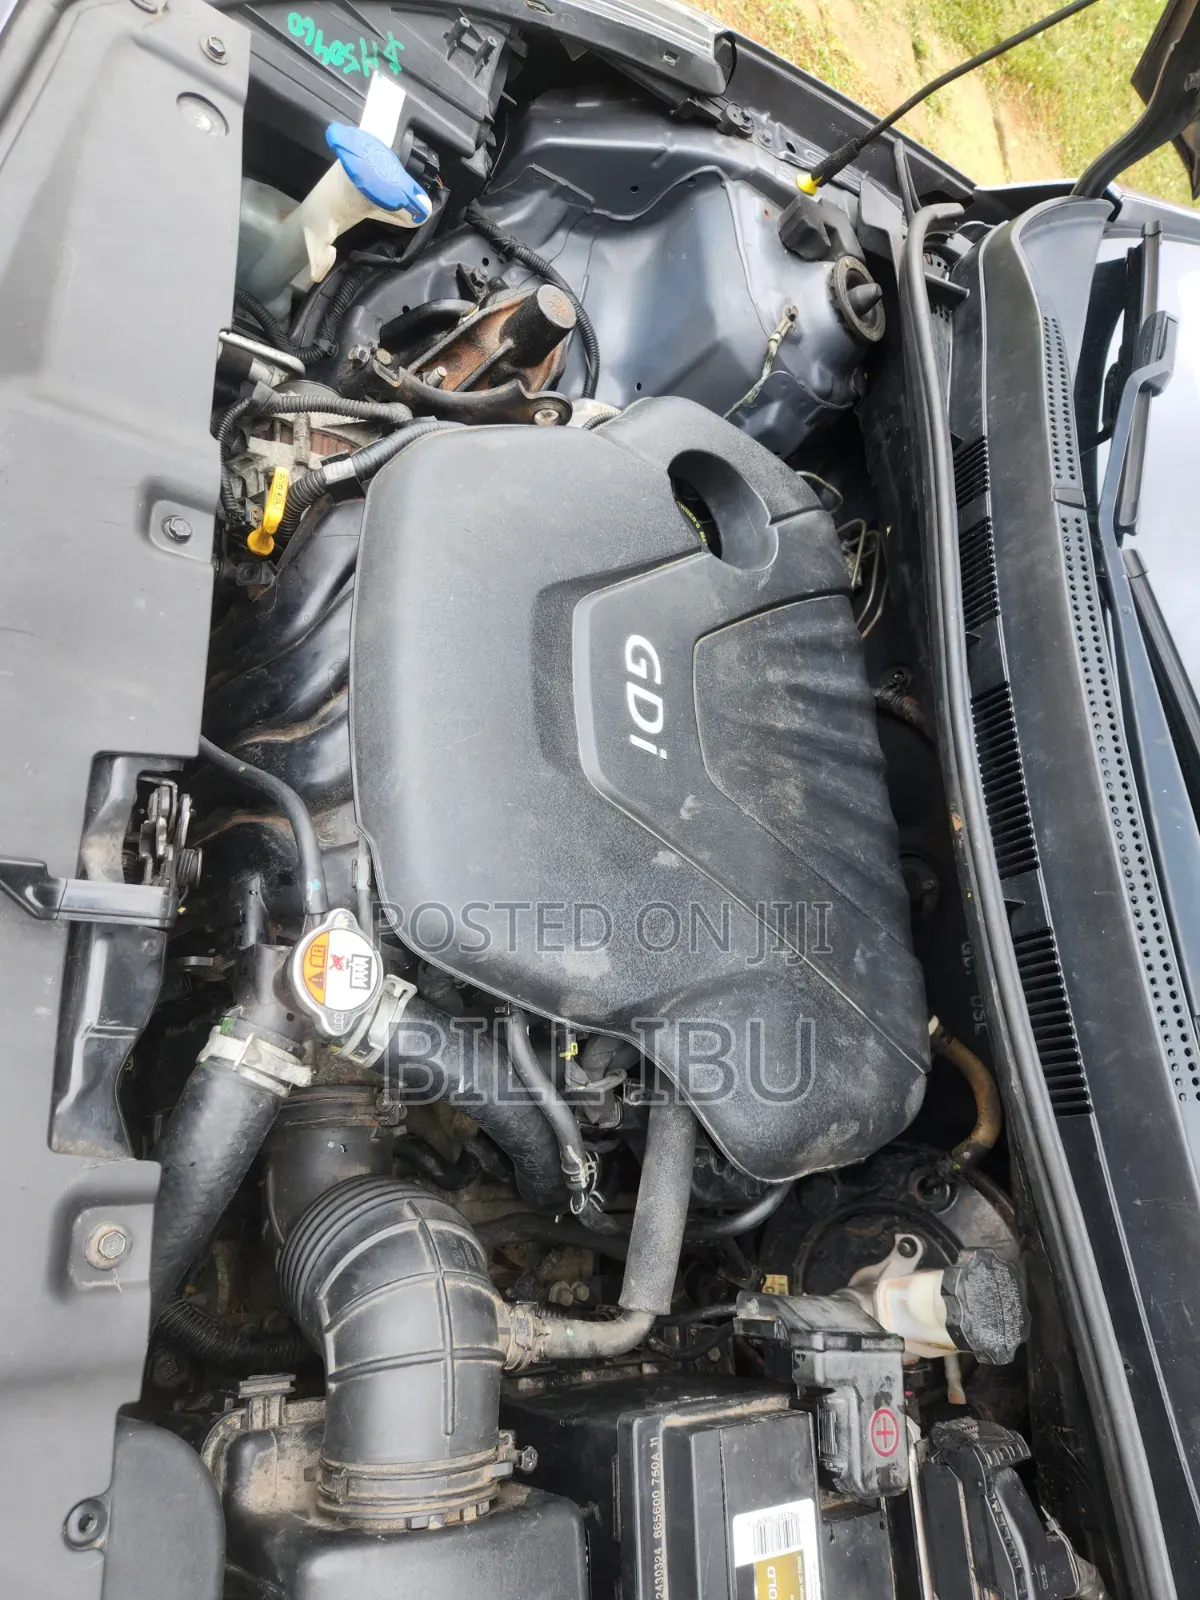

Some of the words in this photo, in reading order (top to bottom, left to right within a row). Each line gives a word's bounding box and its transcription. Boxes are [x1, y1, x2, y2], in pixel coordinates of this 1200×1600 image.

[624, 634, 667, 760] GDi
[650, 1451, 661, 1486] 750A
[651, 1490, 663, 1539] 665600
